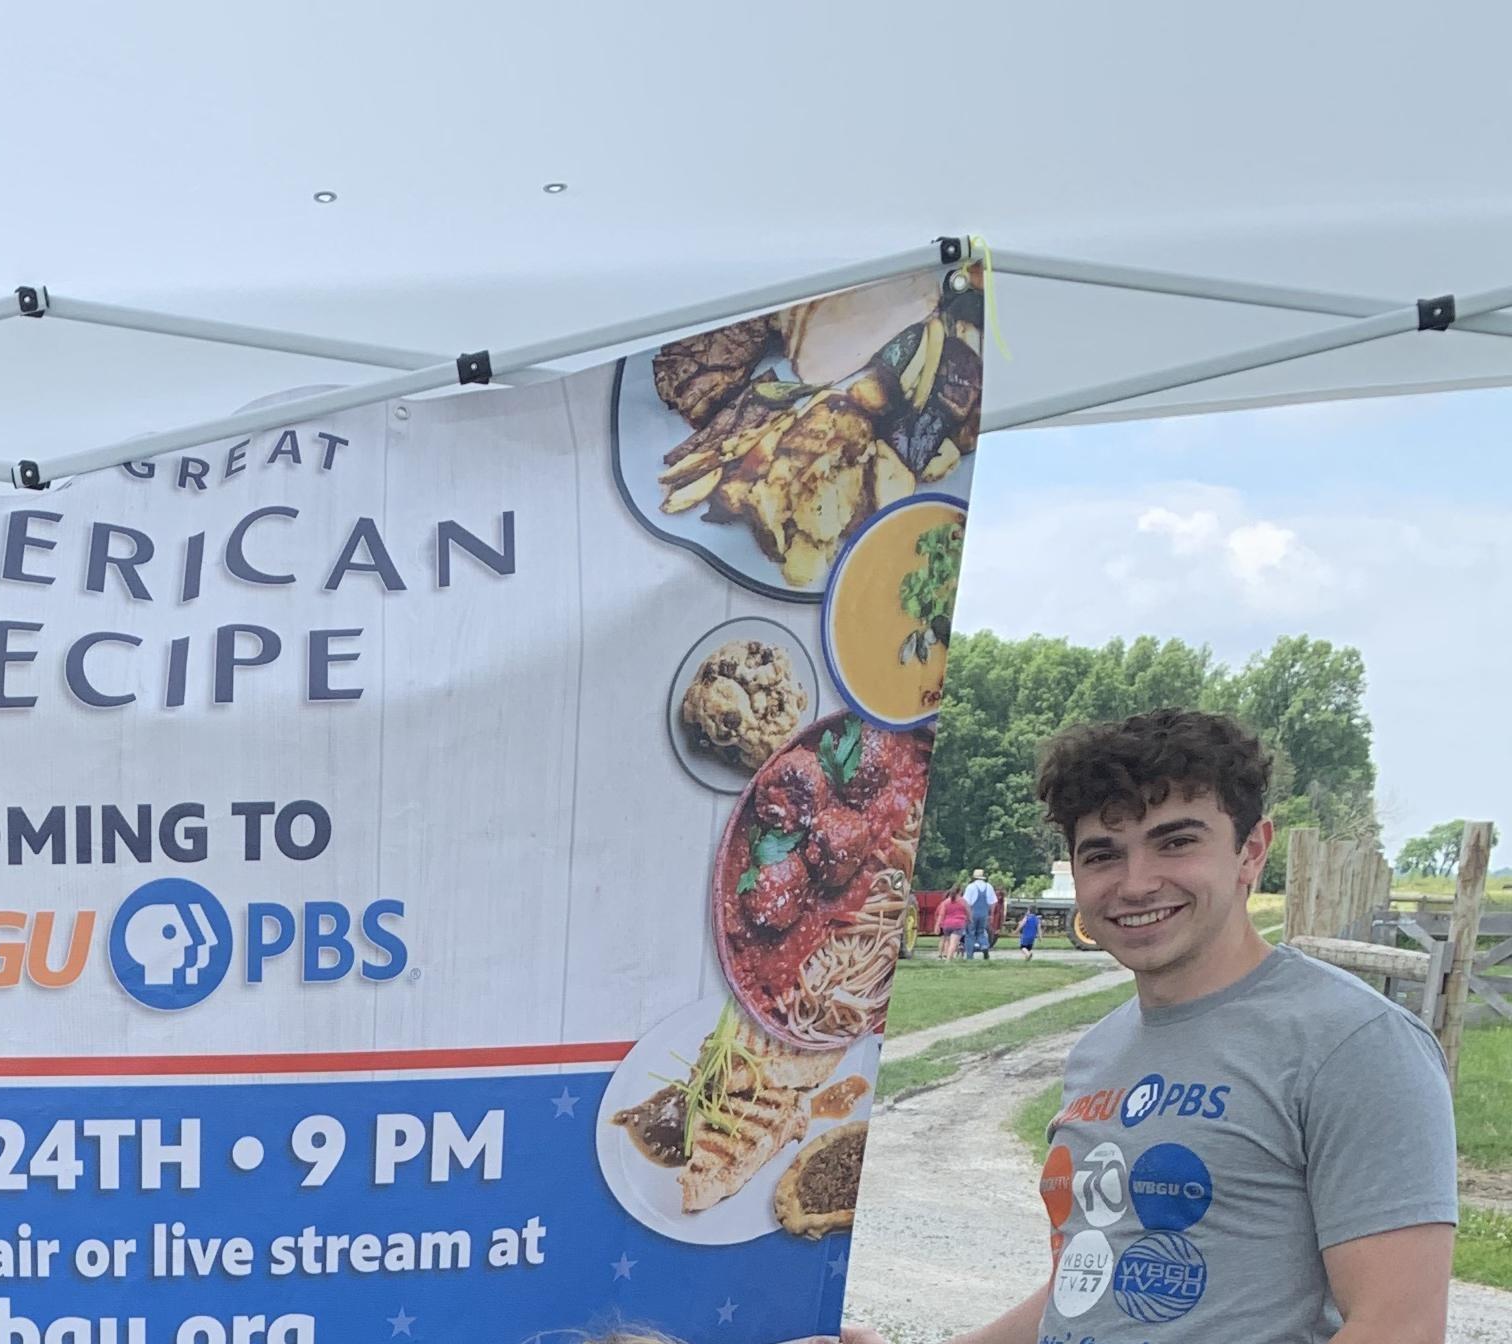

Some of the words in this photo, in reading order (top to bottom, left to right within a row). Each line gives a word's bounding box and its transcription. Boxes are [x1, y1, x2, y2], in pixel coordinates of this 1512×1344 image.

[123, 430, 349, 491] GREAT
[232, 799, 332, 862] TO
[246, 898, 409, 984] PBS
[1157, 1083, 1232, 1120] PBS
[291, 1114, 347, 1187] 9
[375, 1108, 507, 1187] PM
[1133, 1180, 1180, 1197] WBGU
[74, 1234, 136, 1280] or
[152, 1221, 255, 1278] live
[269, 1221, 472, 1275] stream
[487, 1215, 548, 1271] at
[1063, 1252, 1109, 1269] WBGU
[1121, 1260, 1205, 1282] WBGU
[1117, 1274, 1202, 1297] TV-70
